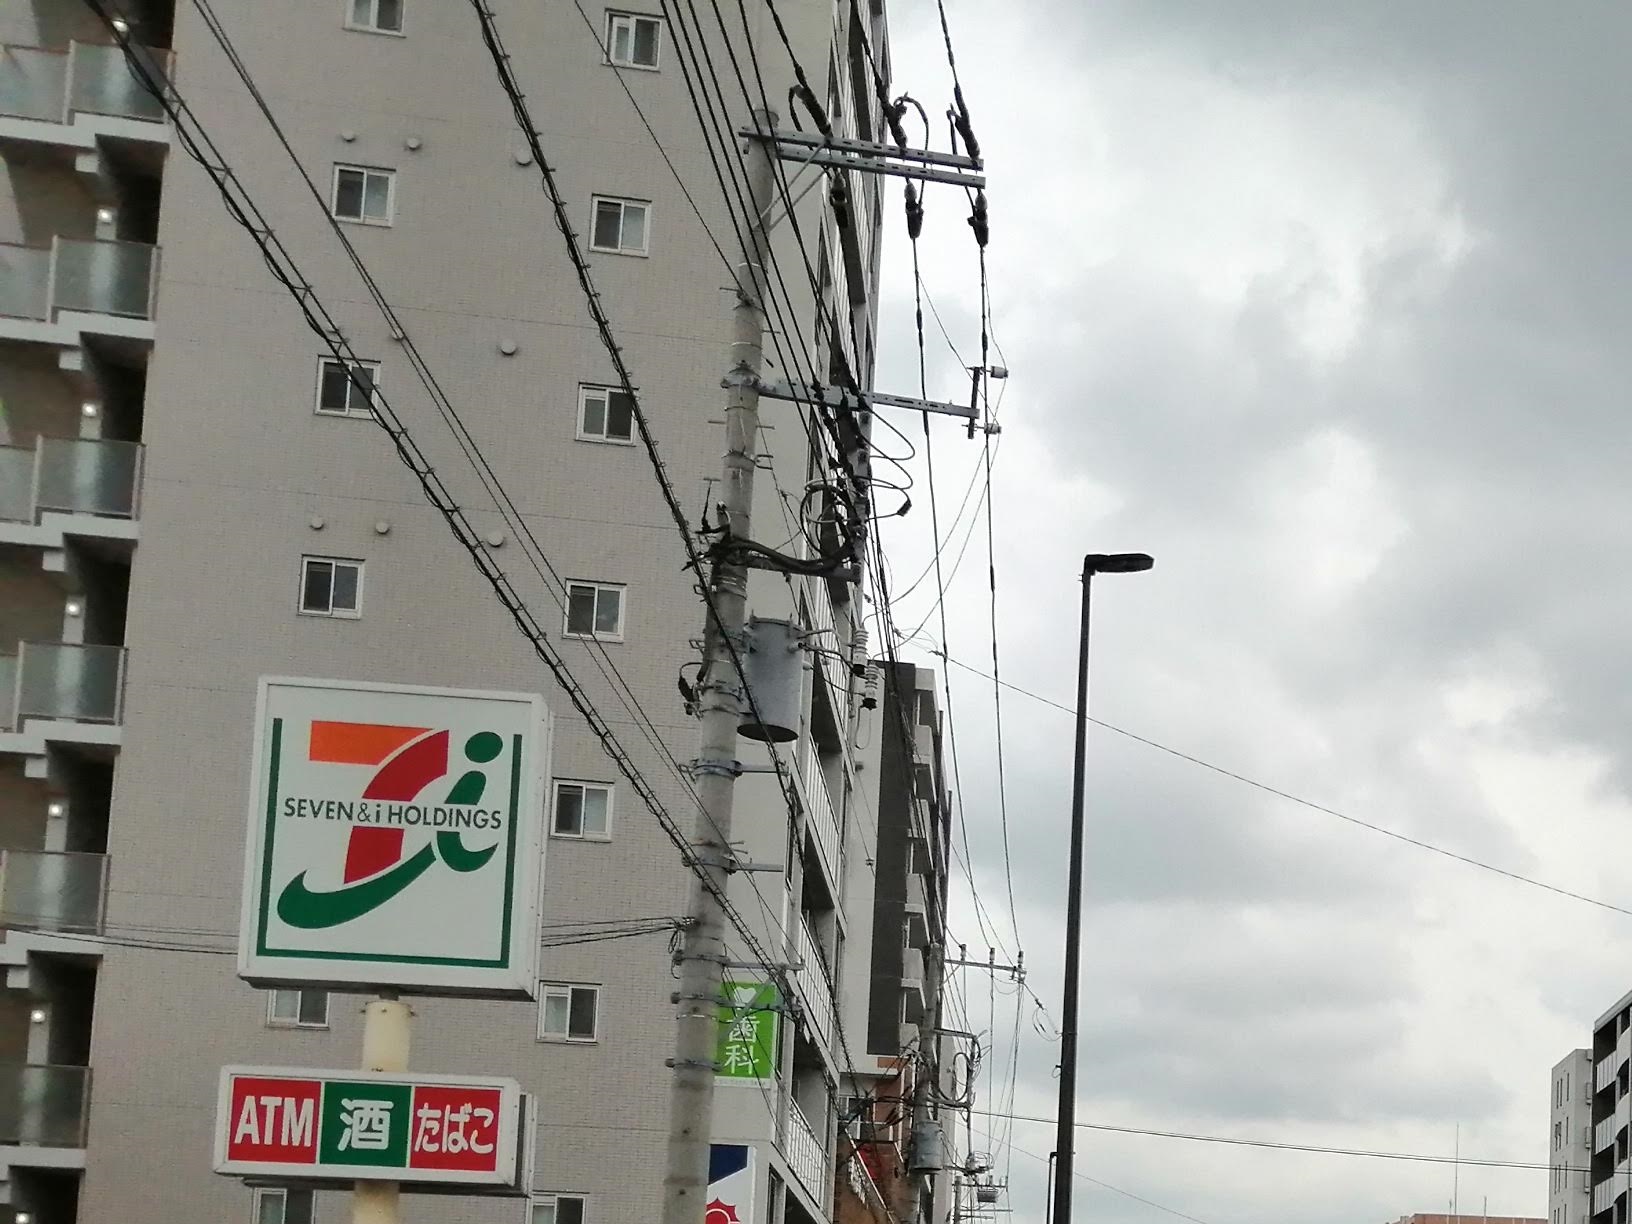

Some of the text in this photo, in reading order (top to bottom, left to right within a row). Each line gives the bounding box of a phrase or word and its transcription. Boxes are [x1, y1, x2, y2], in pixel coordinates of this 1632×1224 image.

[388, 805, 502, 829] HOLDINGS
[234, 1095, 494, 1154] ATM 酒 たばこ
